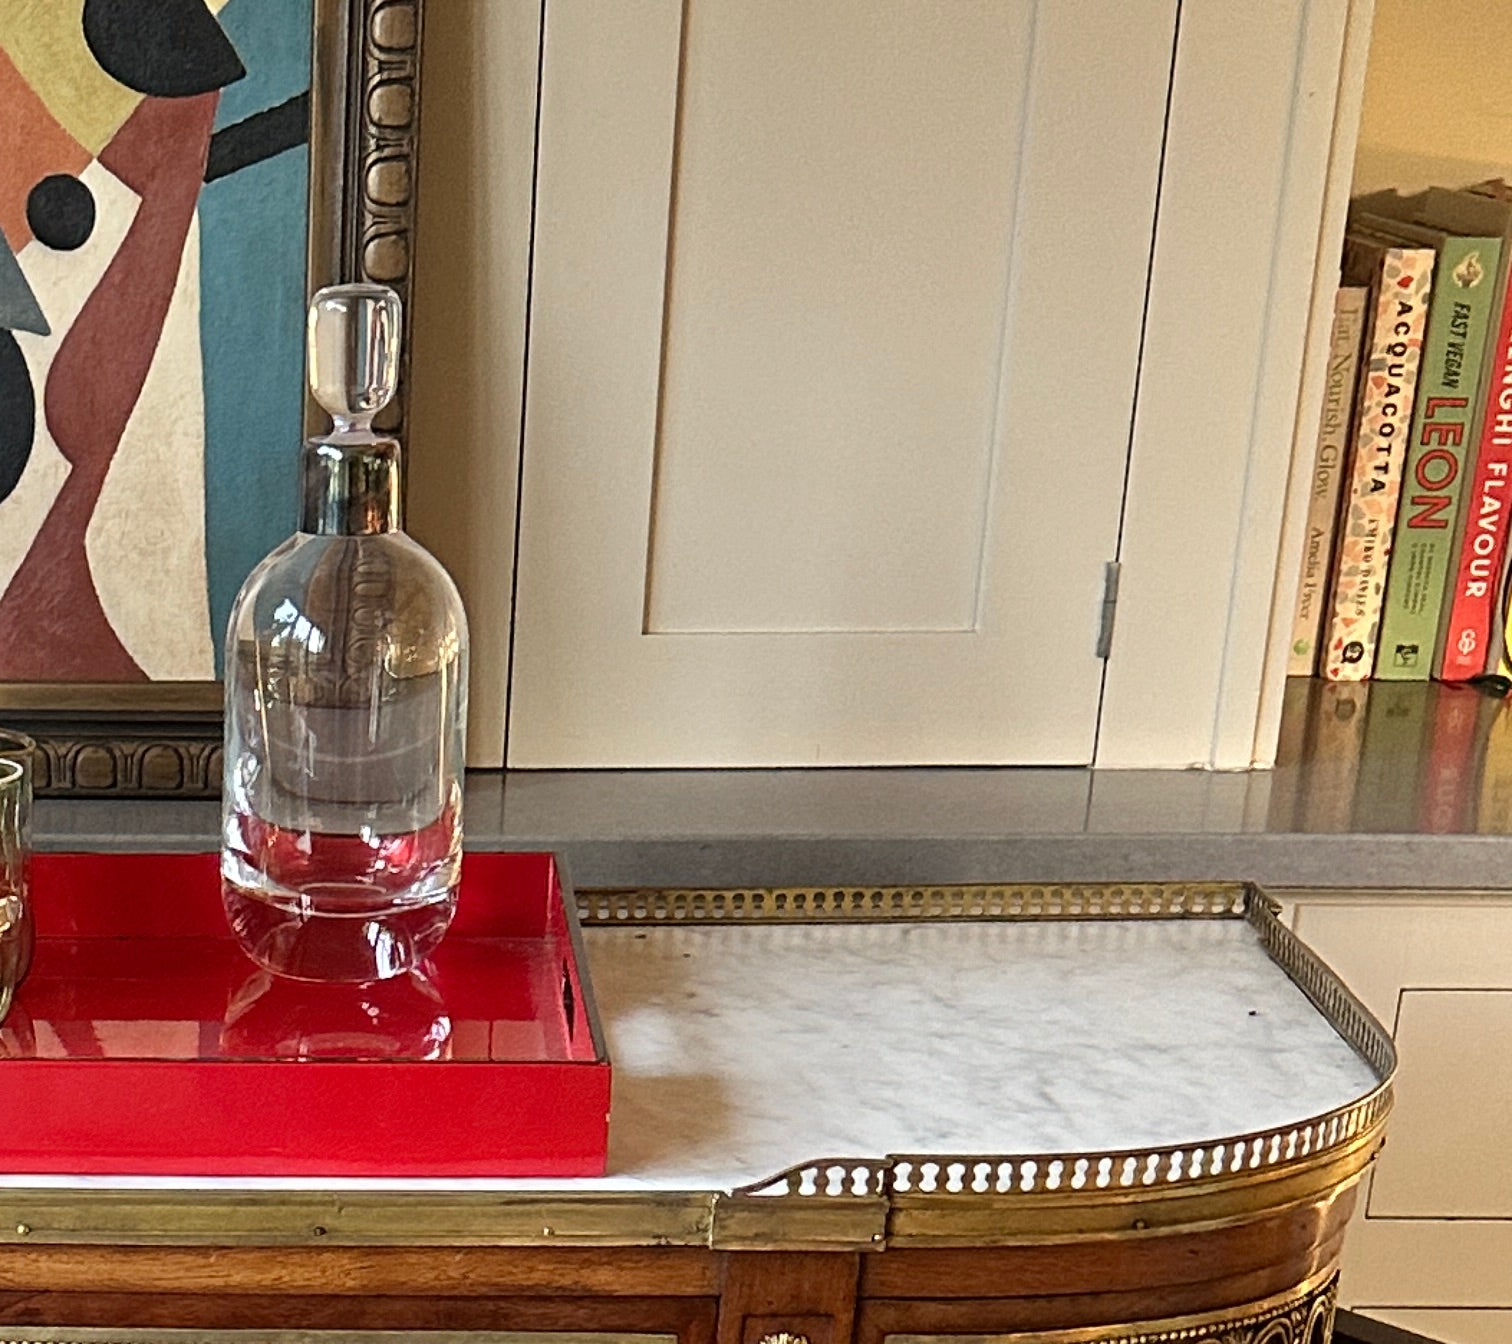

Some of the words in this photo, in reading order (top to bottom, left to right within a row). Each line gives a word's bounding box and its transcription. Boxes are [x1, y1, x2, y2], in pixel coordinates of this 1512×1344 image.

[1442, 340, 1465, 389] VEGAN
[1449, 302, 1471, 339] FAST
[1370, 301, 1414, 493] ACQUACOTTA
[1407, 396, 1470, 529] LEON
[1465, 462, 1508, 597] FLAVOUR
